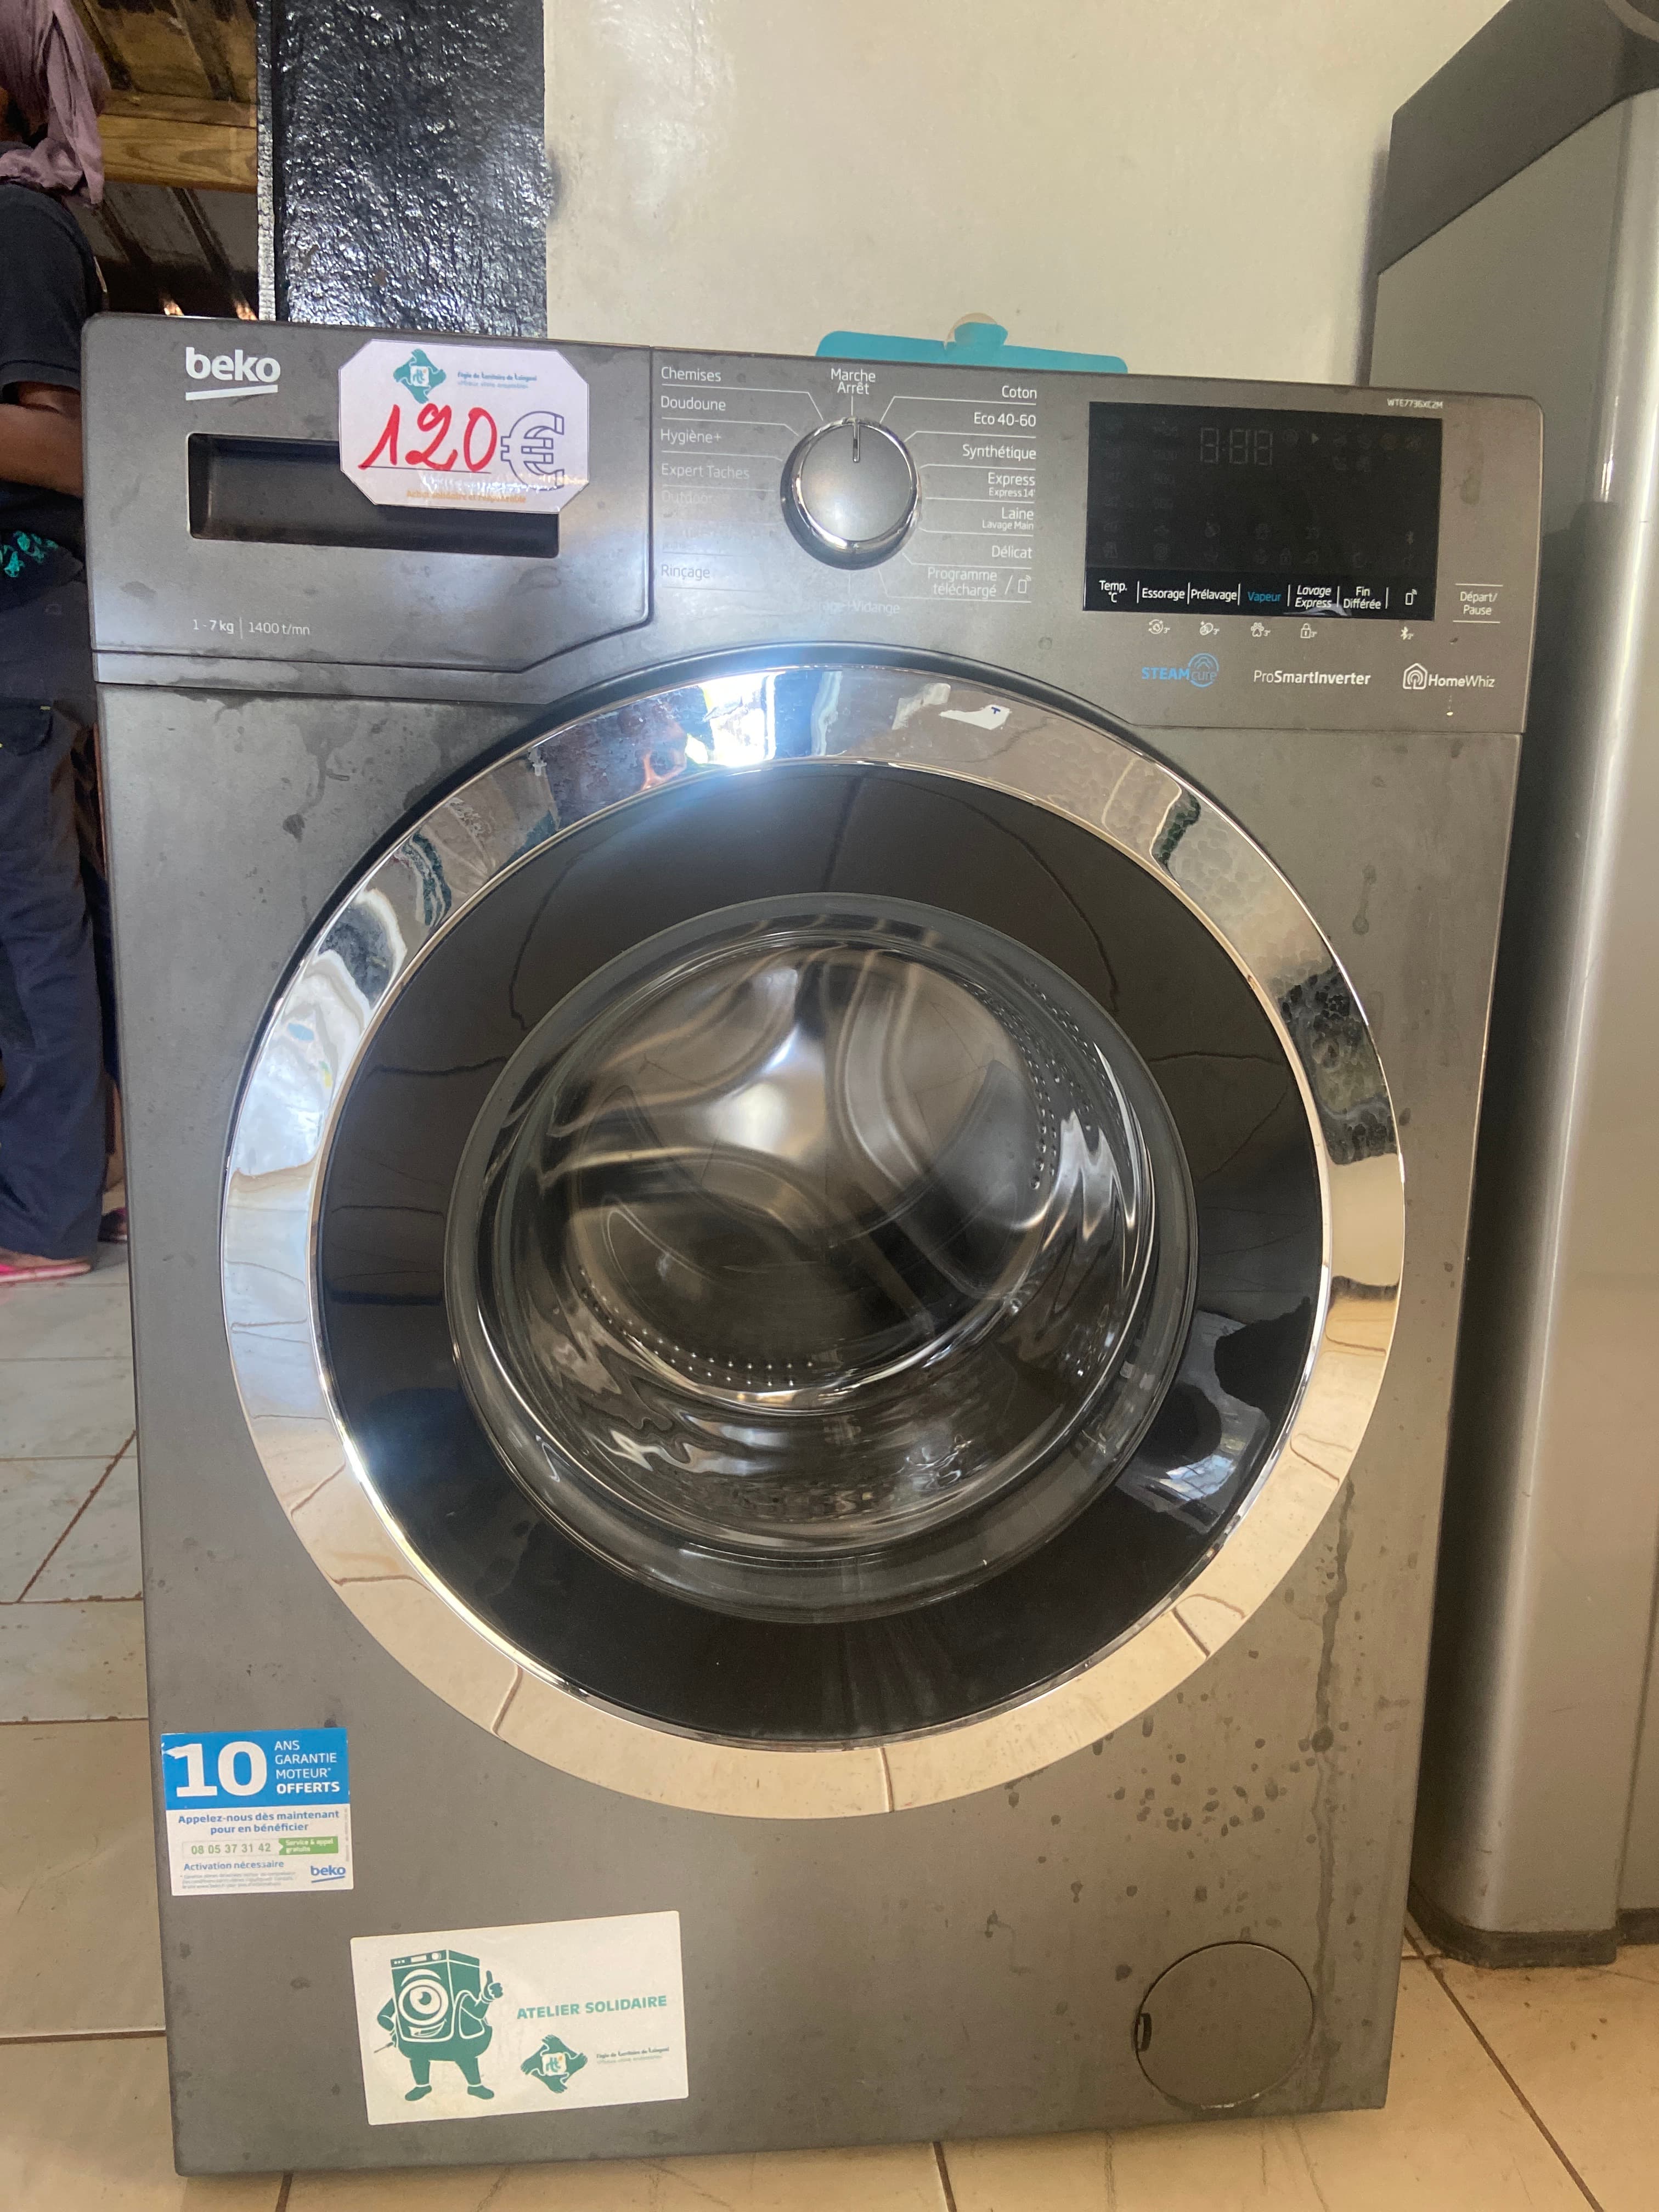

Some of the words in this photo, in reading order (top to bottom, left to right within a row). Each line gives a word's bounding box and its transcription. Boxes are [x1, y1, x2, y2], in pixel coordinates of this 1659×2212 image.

[185, 347, 280, 382] beko
[661, 366, 721, 382] Chemises
[831, 368, 876, 383] Marche
[837, 381, 870, 395] Arrêt
[1002, 385, 1037, 400] Coton
[661, 395, 726, 411] Doudoune
[974, 411, 995, 426] Eco
[997, 413, 1036, 427] 40-60
[661, 428, 722, 445] Hygiène+
[962, 443, 1036, 461] Synthétique
[661, 463, 704, 478] Expert
[707, 465, 750, 479] Taches
[988, 472, 1036, 487] Express
[989, 487, 1022, 498] Express
[1001, 506, 1034, 521] Laine
[982, 520, 1012, 531] Lavage
[1014, 521, 1034, 531] Main
[991, 545, 1032, 559] Délicat
[661, 563, 710, 581] Rinçage
[928, 566, 997, 582] Programme
[933, 583, 997, 600] téléchargé
[1099, 580, 1127, 594] Temp.
[1296, 585, 1332, 597] Lavage
[1356, 586, 1370, 596] Fin
[1108, 591, 1118, 603] °C
[1142, 588, 1186, 602] Essorage
[1190, 589, 1238, 602] Prélavage
[1248, 591, 1282, 602] Vapeur
[1460, 591, 1498, 604] Départ/
[1295, 597, 1332, 610] Express
[1343, 598, 1381, 610] Différée
[1463, 605, 1492, 616] Pause
[249, 622, 279, 634] 1400
[282, 624, 310, 635] t/mn
[1254, 670, 1371, 685] ProSmartInverter
[1427, 674, 1496, 688] HomeWhiz
[274, 1740, 300, 1751] ANS
[275, 1753, 337, 1765] GARANTIE
[174, 1741, 268, 1797] 10
[276, 1782, 340, 1794] OFFERTS
[178, 1814, 253, 1825] Appelez-nous
[255, 1812, 274, 1821] dès
[277, 1810, 339, 1820] maintenant
[210, 1826, 235, 1835] pour
[254, 1822, 308, 1832] bénéficier
[191, 1845, 205, 1854] 08
[208, 1844, 221, 1854] 05
[225, 1844, 237, 1853] 37
[241, 1843, 253, 1853] 31
[258, 1843, 271, 1852] 42
[184, 1863, 232, 1871] Activation
[234, 1860, 284, 1869] nécessaire
[310, 1865, 346, 1876] beko
[517, 2004, 580, 2020] ATELIER
[585, 1995, 668, 2014] SOLIDAIRE
